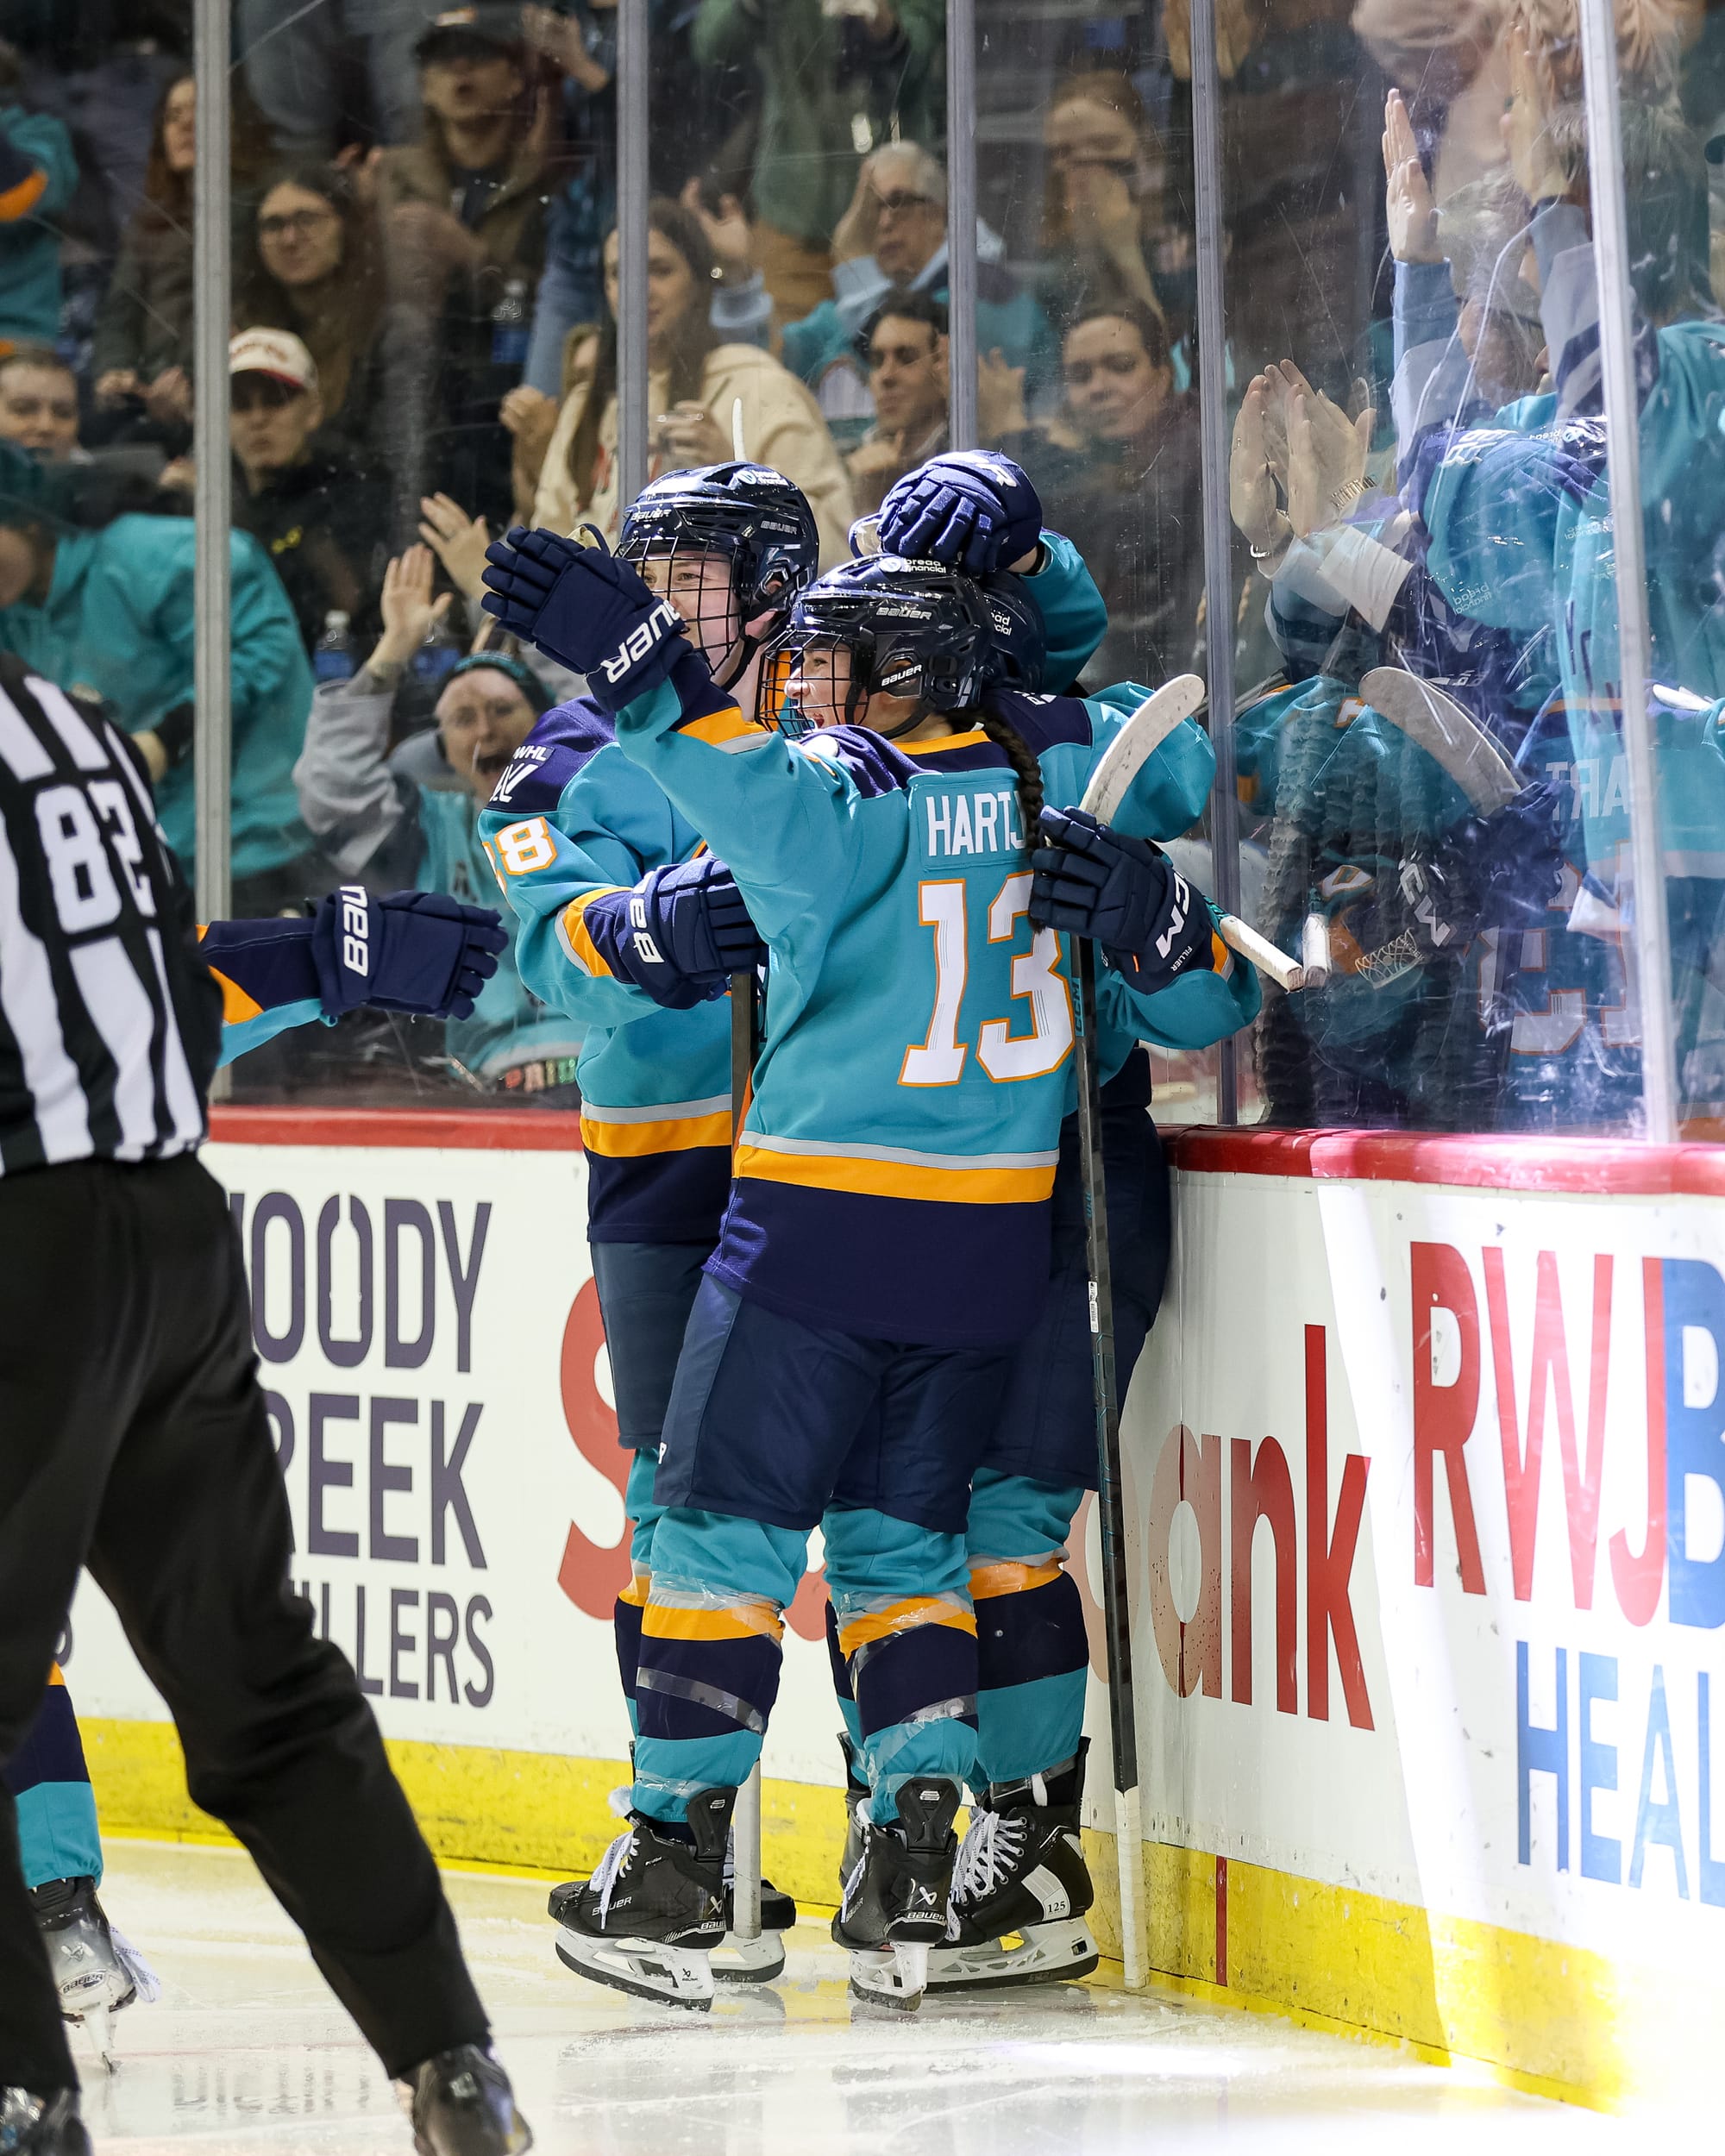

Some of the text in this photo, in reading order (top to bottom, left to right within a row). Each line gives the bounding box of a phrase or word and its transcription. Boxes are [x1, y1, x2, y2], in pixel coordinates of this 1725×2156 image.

[875, 607, 932, 621] BAUER
[881, 664, 922, 686] BAUER
[35, 780, 156, 934] 82
[482, 816, 558, 895] 8
[1156, 871, 1190, 959] CM
[897, 868, 1076, 1087] 13
[1170, 945, 1193, 972] FILLIER
[230, 1191, 492, 1373] OODY
[906, 1911, 946, 1921] BAUER
[1047, 1901, 1066, 1914] 125
